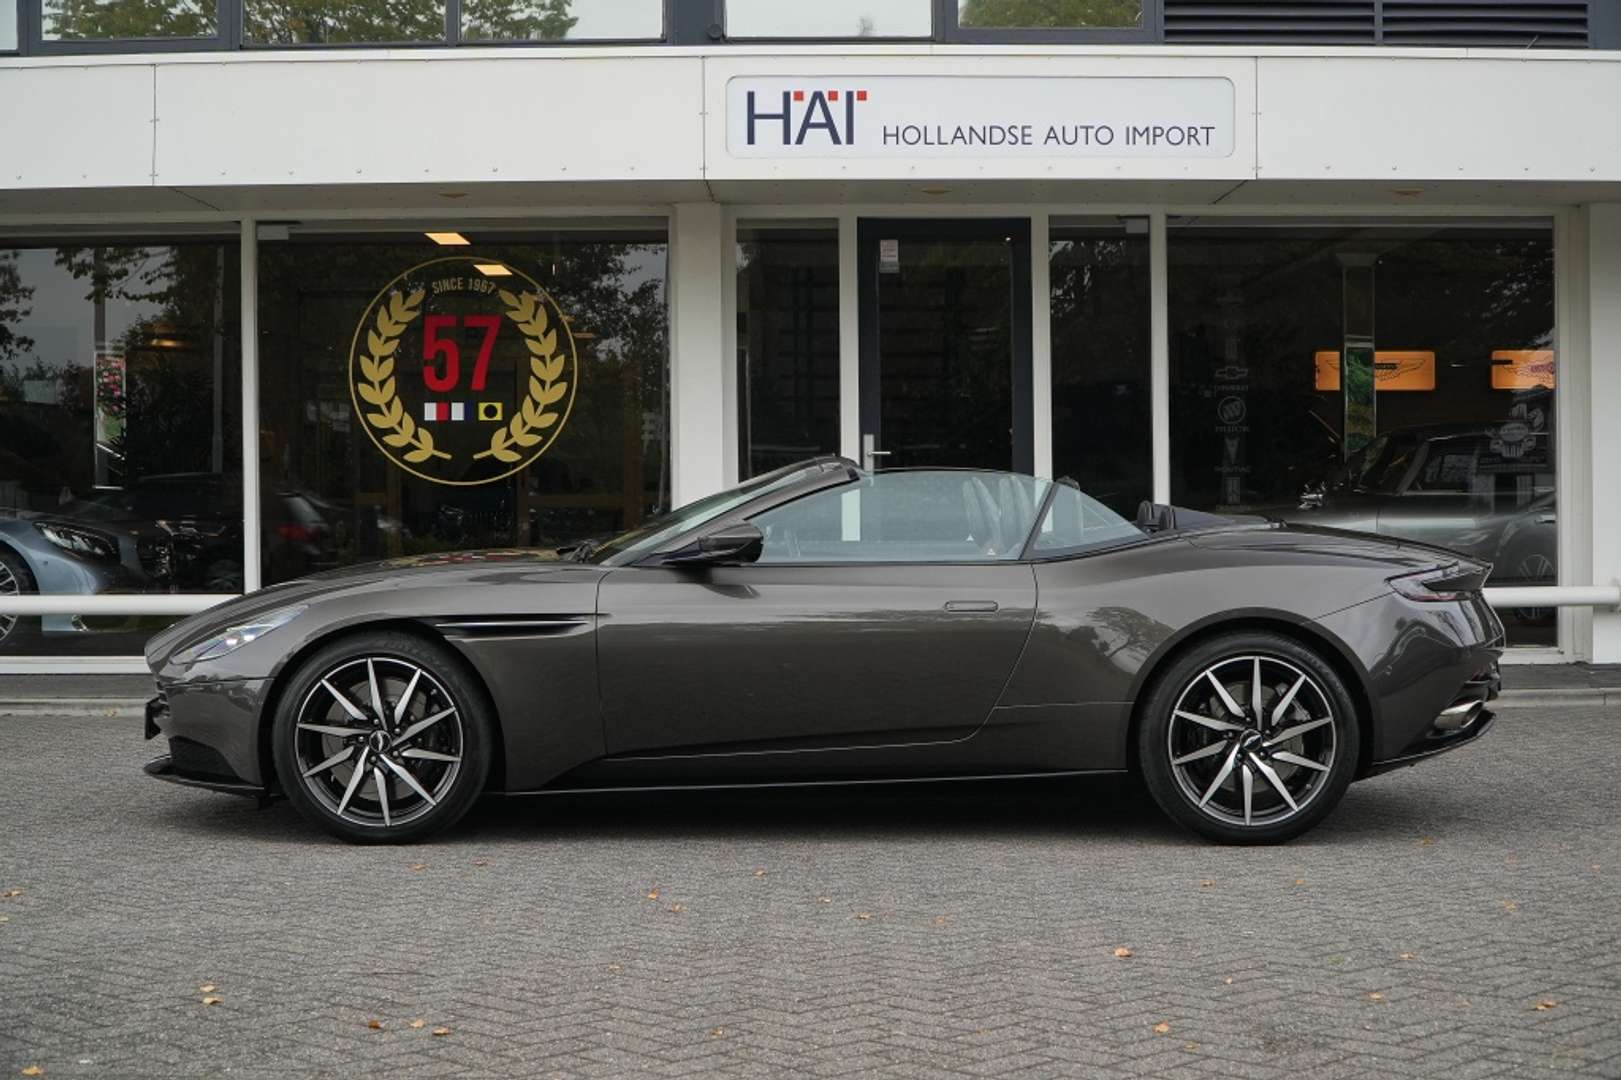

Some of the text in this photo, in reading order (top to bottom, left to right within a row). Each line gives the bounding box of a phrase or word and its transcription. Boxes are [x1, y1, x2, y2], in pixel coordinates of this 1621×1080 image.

[883, 125, 1033, 146] HOLLANDSE
[1043, 125, 1114, 146] AUTO
[1126, 125, 1216, 146] IMPORT
[431, 277, 497, 295] SINCE 1967
[423, 315, 501, 392] 57
